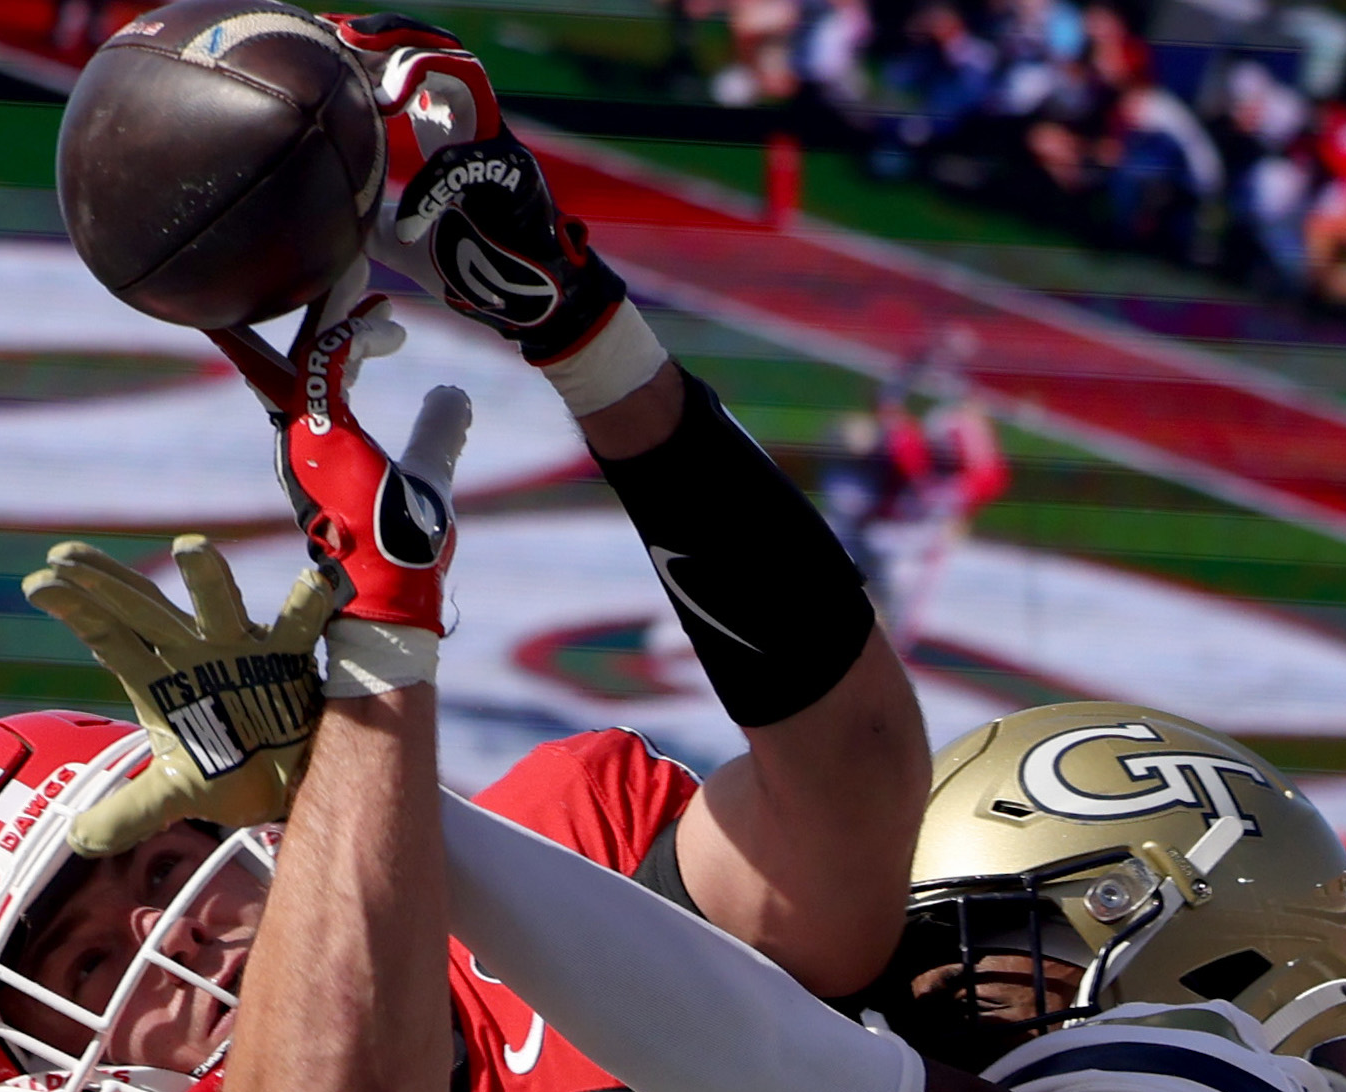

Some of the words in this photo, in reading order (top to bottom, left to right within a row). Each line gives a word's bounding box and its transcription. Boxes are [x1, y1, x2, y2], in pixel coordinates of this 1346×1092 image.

[306, 316, 373, 436] GEORGIA
[148, 671, 197, 713] IT'S
[193, 659, 236, 698] ALL
[167, 694, 245, 775] THE
[0, 766, 77, 854] DAWGS
[1019, 723, 1275, 838] GT
